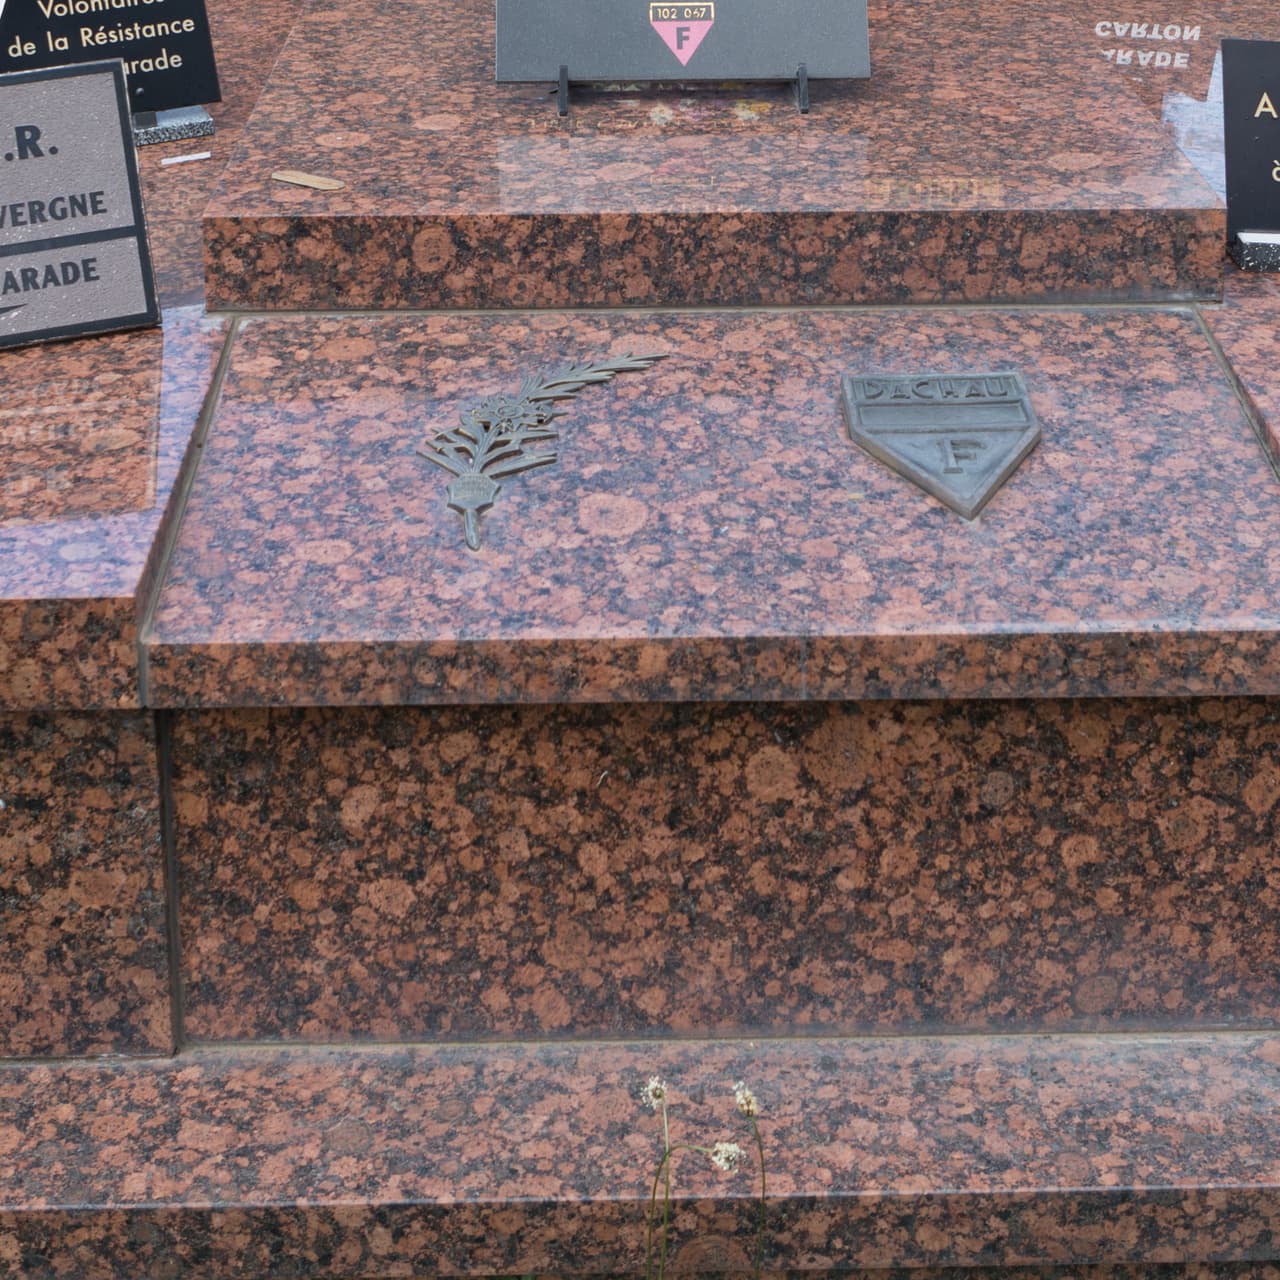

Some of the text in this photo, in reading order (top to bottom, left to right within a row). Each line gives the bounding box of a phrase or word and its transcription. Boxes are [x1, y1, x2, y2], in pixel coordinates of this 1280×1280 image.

[8, 16, 195, 58] de la Résistance
[676, 26, 690, 50] F
[861, 379, 1008, 400] DACHAU
[936, 438, 987, 474] F
